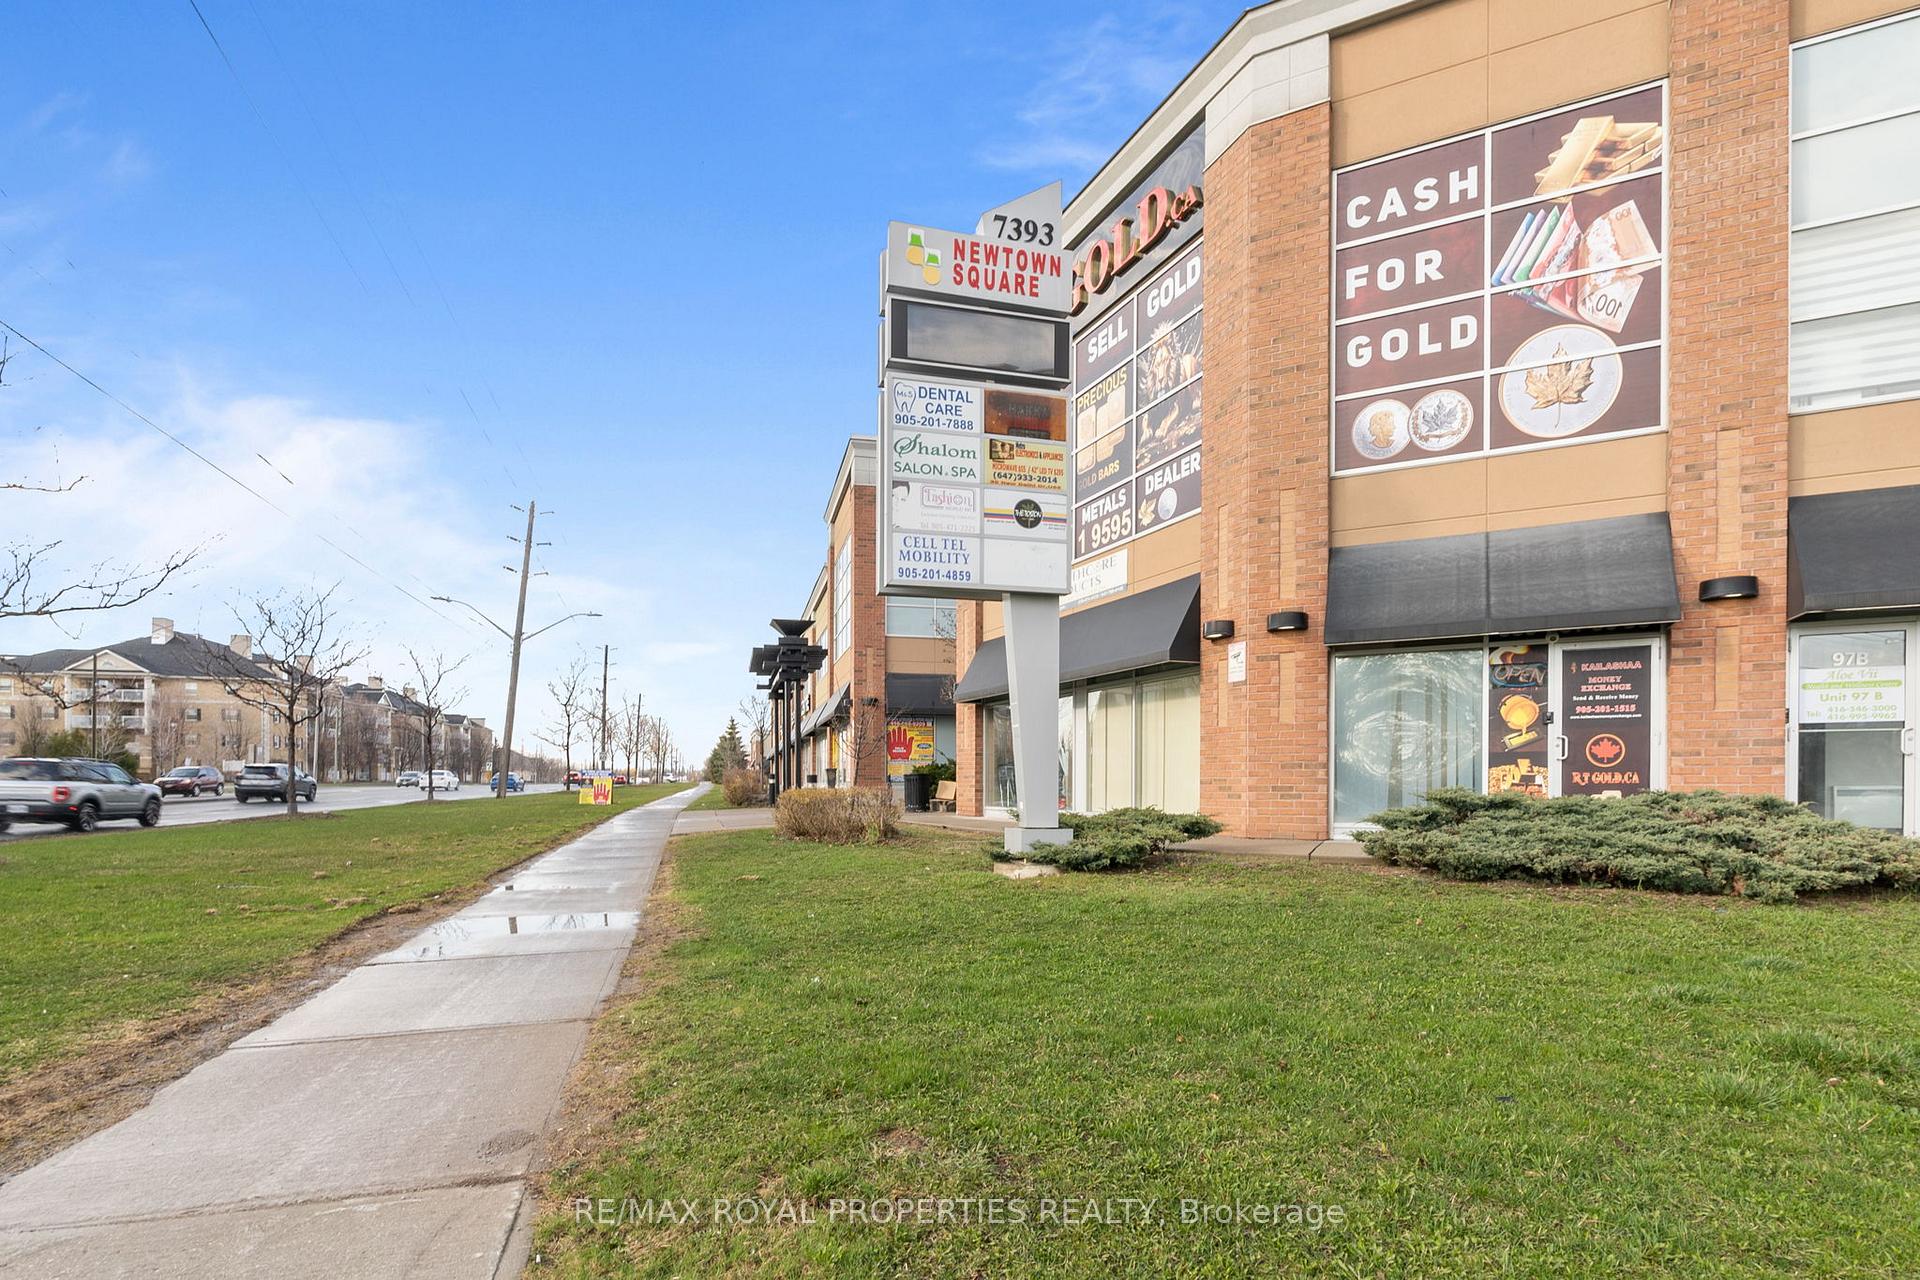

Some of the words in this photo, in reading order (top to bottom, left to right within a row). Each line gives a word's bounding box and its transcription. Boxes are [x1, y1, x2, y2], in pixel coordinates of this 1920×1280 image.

[1345, 164, 1479, 229] CASH
[993, 214, 1055, 247] 7393
[953, 238, 1062, 278] NEWTOWN
[952, 262, 1040, 298] SQUARE
[1345, 248, 1445, 301] FOR
[1088, 315, 1129, 364] SELL
[1146, 254, 1201, 319] GOLD
[1345, 313, 1479, 369] GOLD
[918, 386, 974, 404] DENTAL
[1077, 366, 1128, 411] PRECIOUS
[925, 402, 963, 417] CARE
[894, 413, 974, 431] 905-201-7888
[893, 433, 977, 460] Shalom
[894, 461, 944, 476] SALON
[951, 465, 977, 479] SPA
[1098, 459, 1120, 481] BARS
[1081, 487, 1127, 525] METALS
[1145, 451, 1201, 496] DEALER
[1078, 530, 1086, 554] 1
[1091, 507, 1132, 550] 9595
[903, 535, 938, 550] CELL
[942, 538, 967, 551] TEL
[899, 549, 970, 565] MOBILITY
[898, 566, 972, 582] 905-201-4859
[1832, 651, 1869, 667] 97B
[1494, 665, 1546, 686] OPEN
[1588, 675, 1622, 684] MONEY
[1580, 683, 1632, 693] EXCHANGE
[1819, 691, 1847, 703] Unit
[1851, 691, 1870, 701] 97
[1874, 691, 1884, 701] B
[1591, 771, 1640, 785] GOLD.CA
